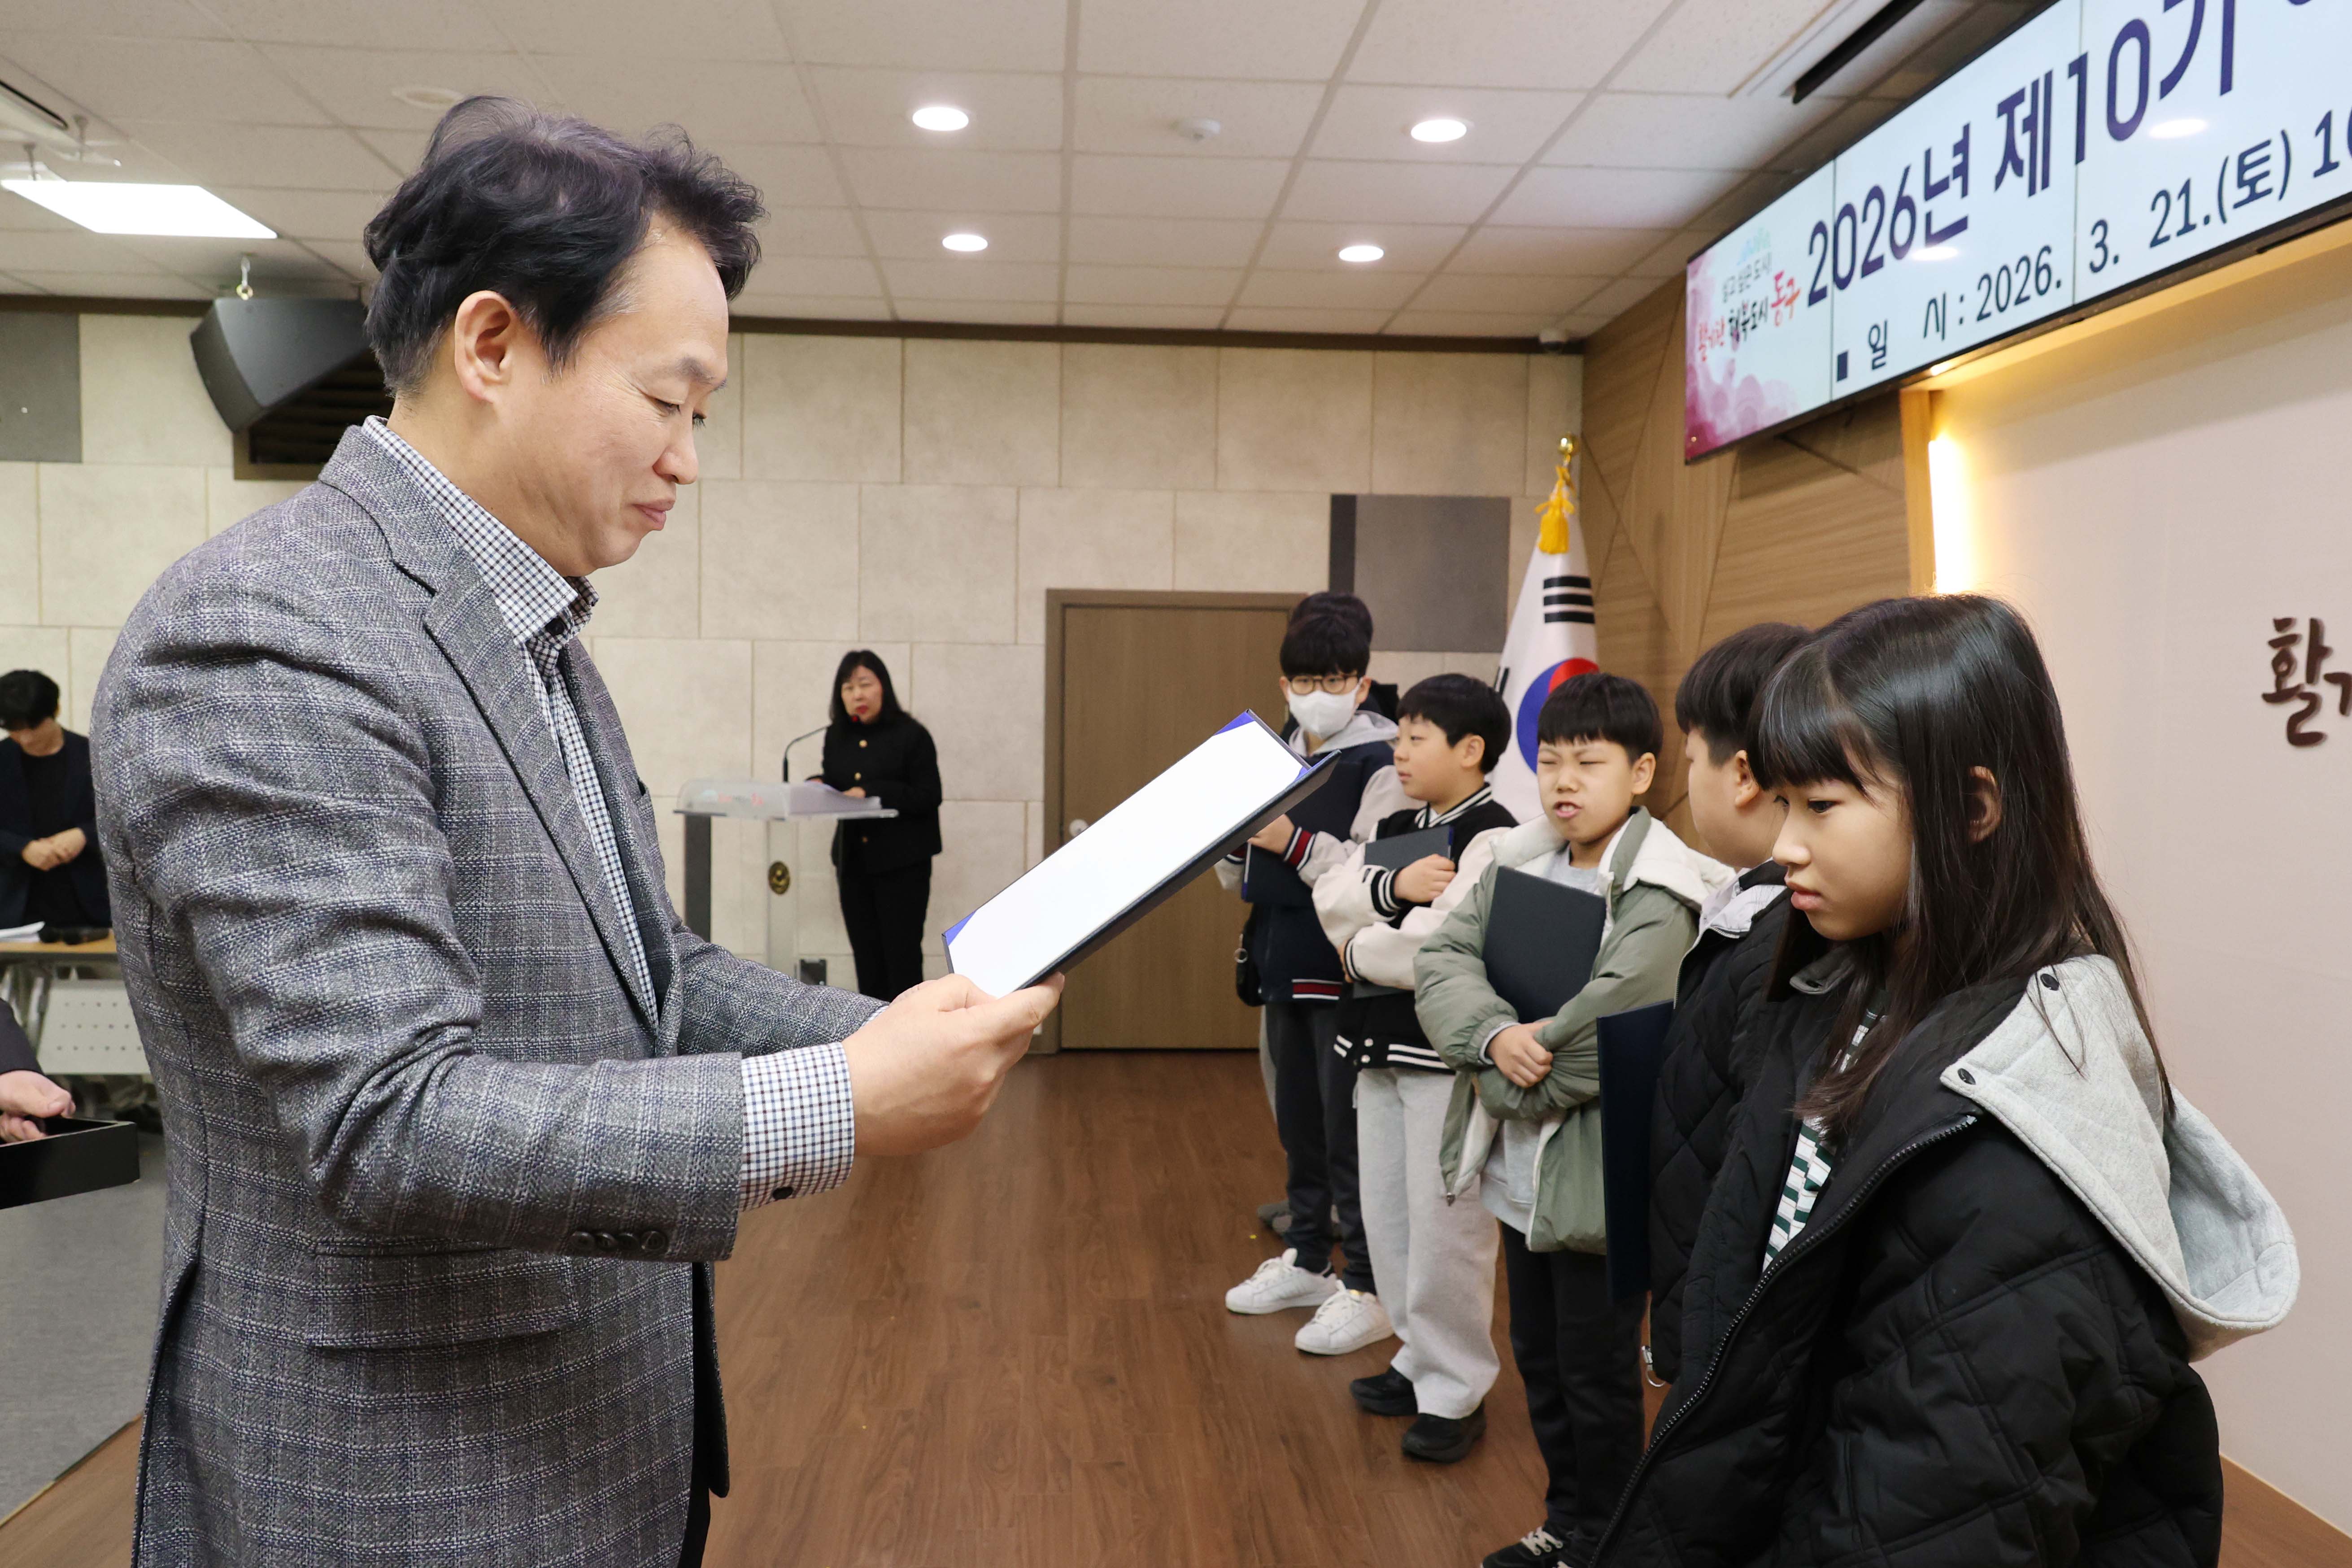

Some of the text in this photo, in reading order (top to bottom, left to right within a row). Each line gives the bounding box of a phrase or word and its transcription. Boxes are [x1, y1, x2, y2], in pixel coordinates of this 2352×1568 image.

[1770, 270, 1801, 327] 동구
[1808, 121, 1971, 308] 2026년
[1868, 319, 1888, 370] 일
[2089, 218, 2120, 274] 3.
[2313, 109, 2352, 179] 1
